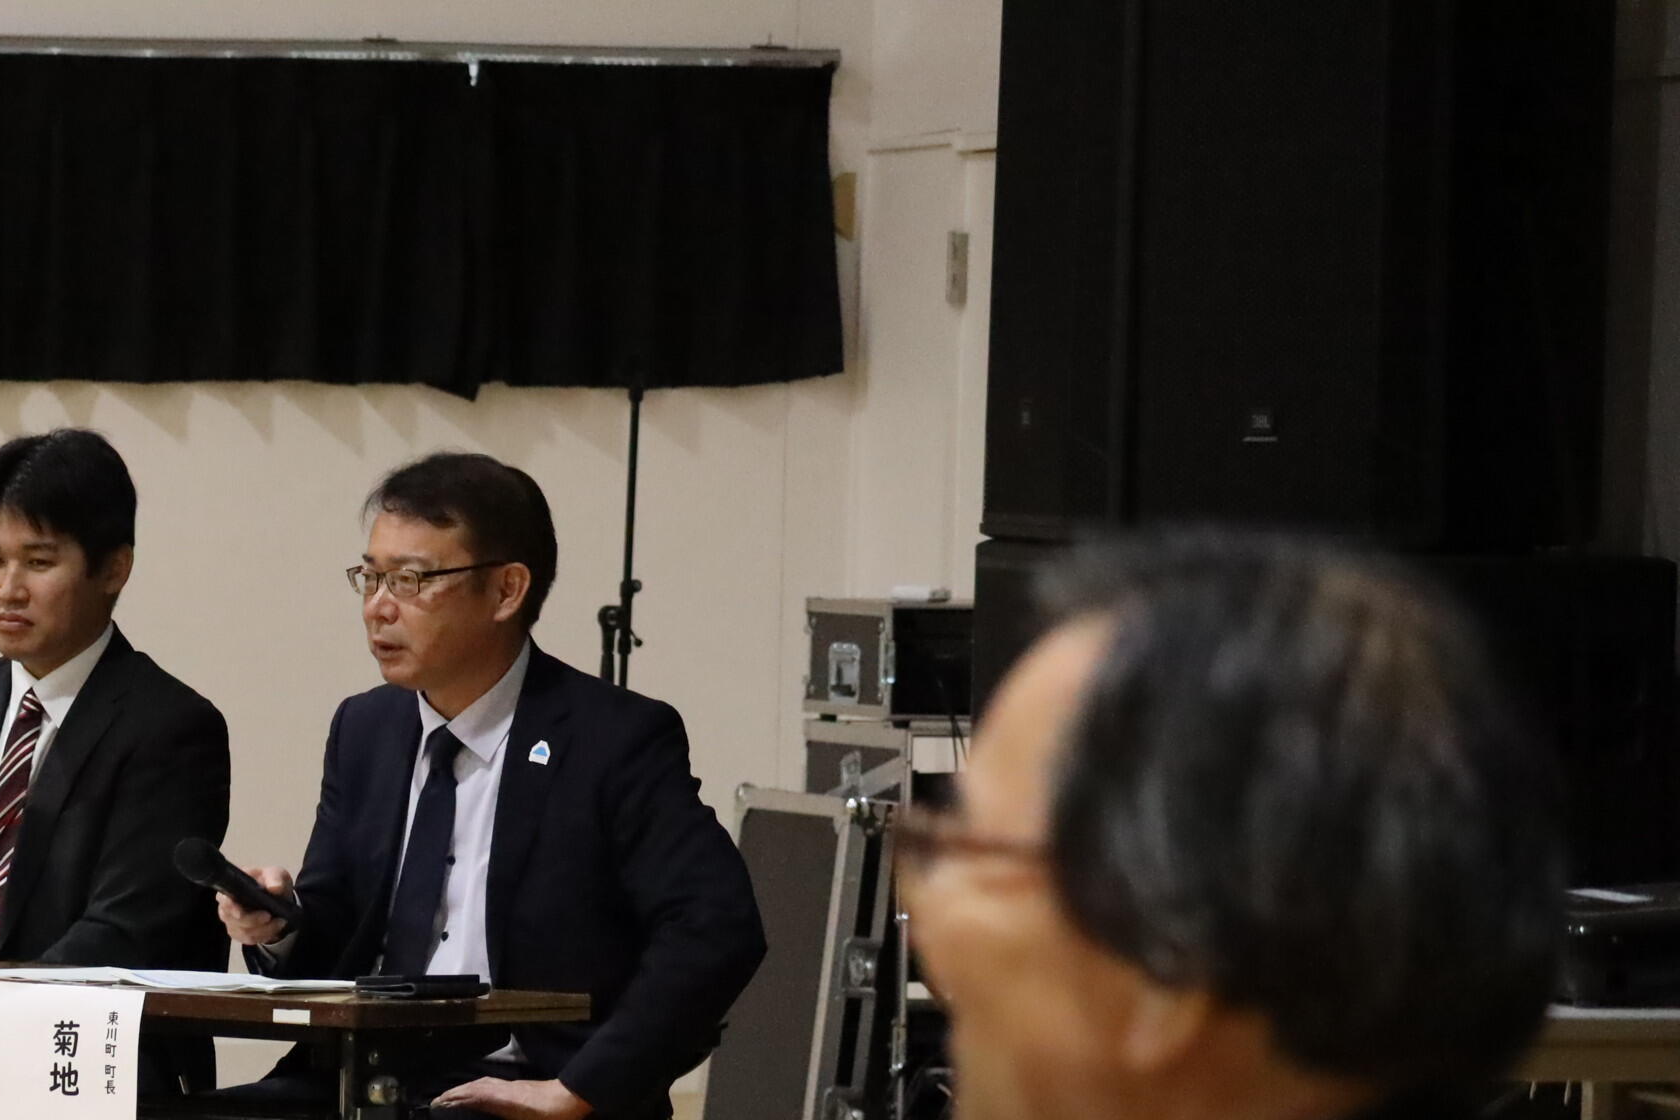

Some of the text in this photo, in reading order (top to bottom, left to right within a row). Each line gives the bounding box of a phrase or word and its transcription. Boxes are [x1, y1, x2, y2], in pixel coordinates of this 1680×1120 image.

[49, 1020, 80, 1097] 菊地
[104, 1011, 119, 1095] 東川町 町長
